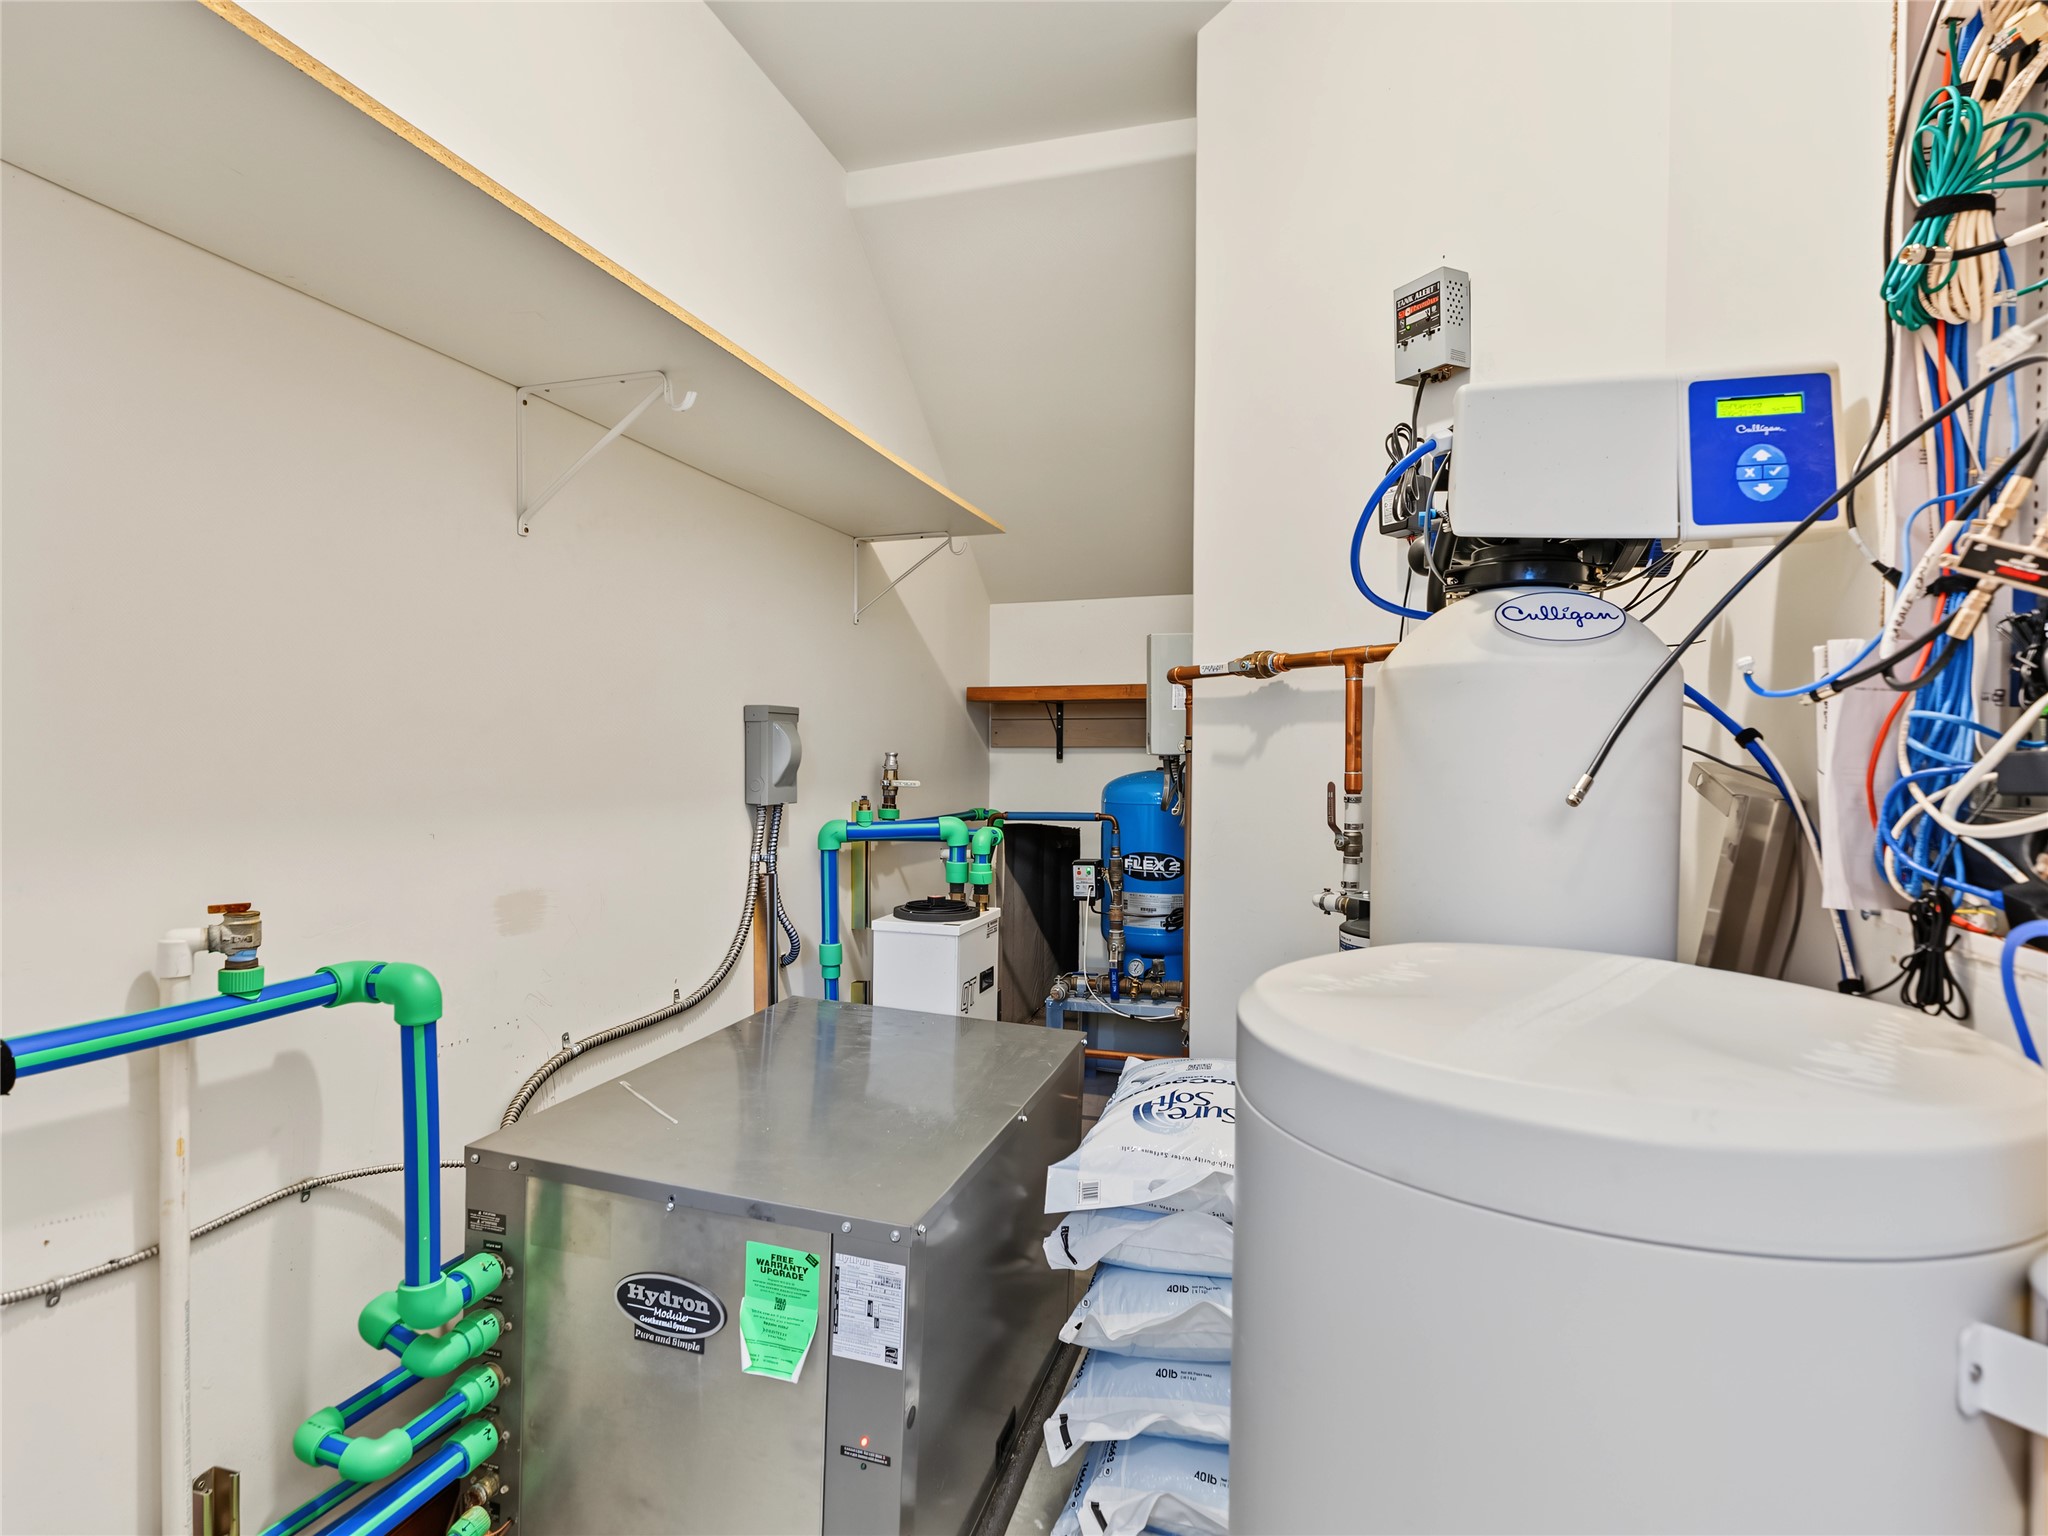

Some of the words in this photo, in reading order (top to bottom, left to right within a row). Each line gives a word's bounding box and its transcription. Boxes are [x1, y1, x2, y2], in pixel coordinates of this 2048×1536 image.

[1397, 294, 1414, 308] TANK
[1414, 285, 1436, 301] ALERT
[1736, 424, 1784, 436] Culligan
[1502, 605, 1619, 628] Culligan
[1152, 1089, 1214, 1112] Soft
[1167, 1105, 1236, 1124] Sure
[756, 1257, 809, 1275] WARRANTY
[771, 1253, 794, 1265] FREE
[760, 1266, 804, 1281] UPGRADE
[1167, 1284, 1189, 1293] 40lb
[627, 1283, 710, 1315] Hydron
[639, 1314, 673, 1329] Geothermal
[672, 1321, 697, 1334] Systems
[635, 1328, 655, 1341] Pure
[655, 1335, 671, 1345] and
[672, 1338, 700, 1352] Simple
[1155, 1368, 1178, 1379] 40lb
[1194, 1470, 1217, 1486] 40lb
